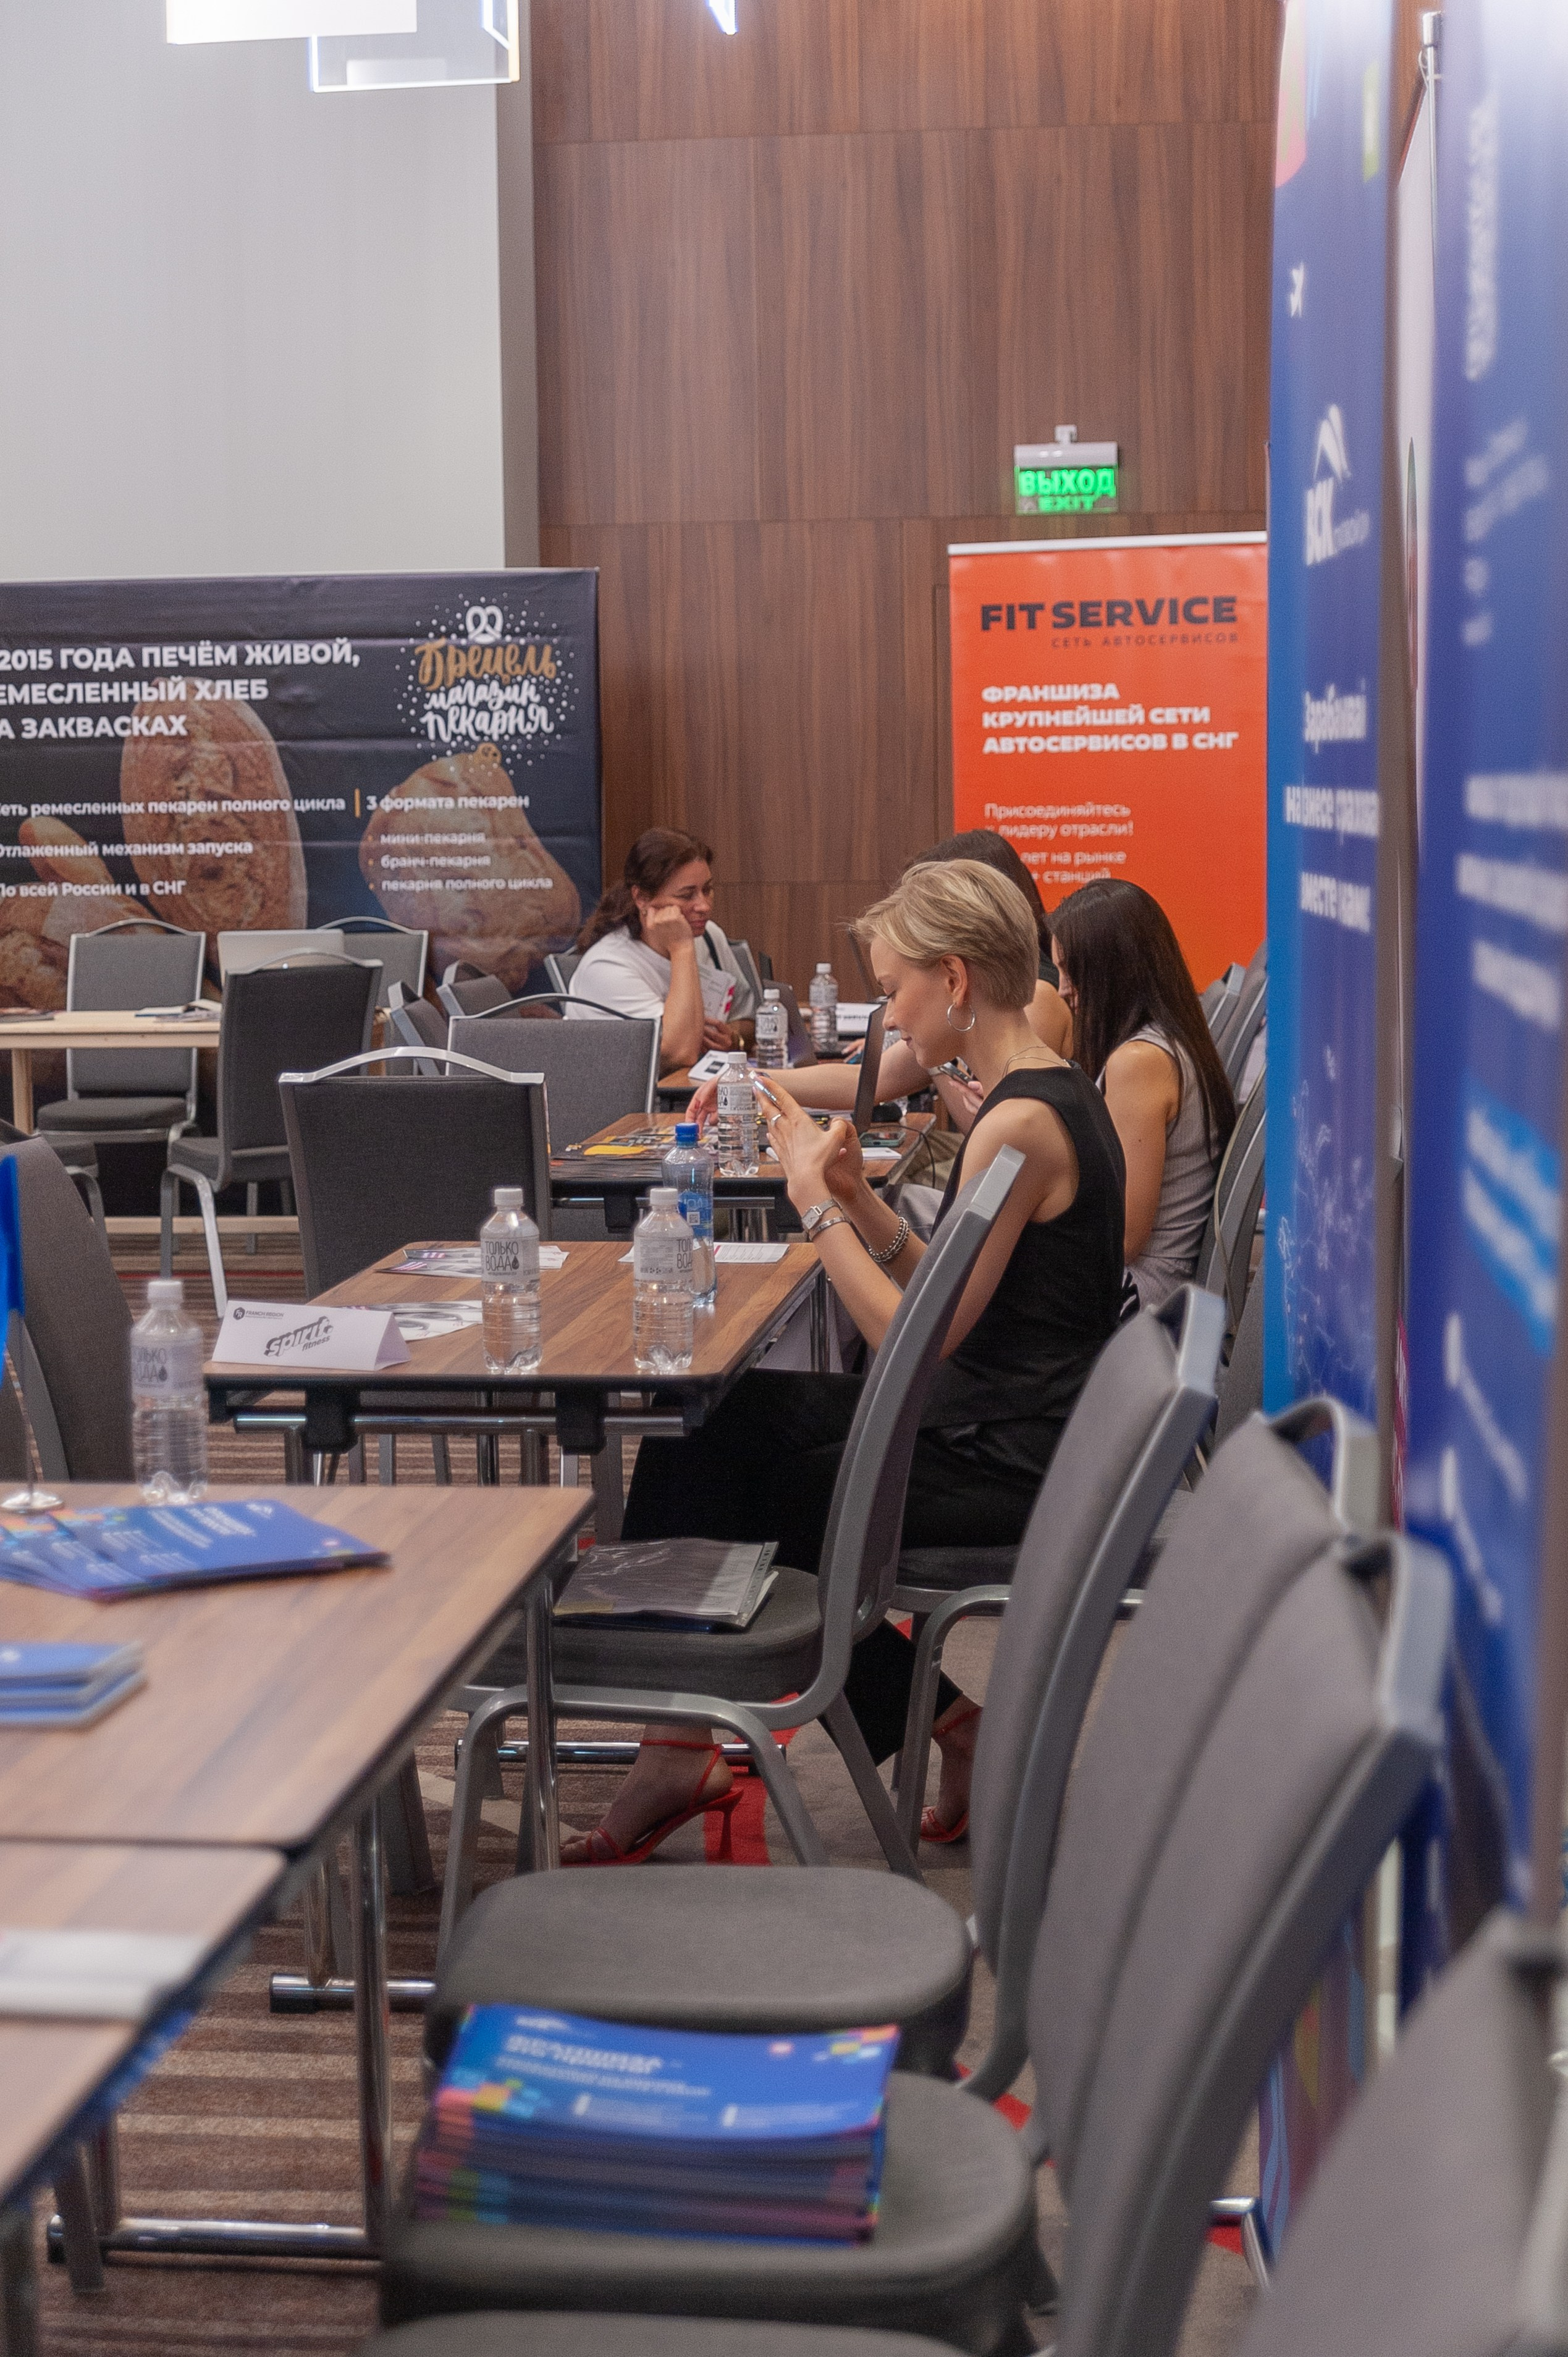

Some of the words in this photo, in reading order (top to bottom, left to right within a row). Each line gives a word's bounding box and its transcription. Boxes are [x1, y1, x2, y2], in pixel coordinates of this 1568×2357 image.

[1019, 468, 1116, 498] ВЫХОД
[980, 602, 1045, 631] FIT
[1052, 595, 1237, 629] SERVICE
[1052, 637, 1092, 648] СЕТЬ
[1102, 632, 1239, 646] АВТОСЕРВИСОВ
[0, 648, 54, 671] 2015
[60, 647, 135, 672] ГОДА
[141, 640, 237, 668] ПЕЧЁМ
[245, 637, 361, 667] ЖИВОЙ,
[415, 637, 556, 690] Брецель
[195, 679, 269, 701] ХЛЕБ
[982, 683, 1120, 703] ФРАНШИЗА
[21, 715, 188, 739] ЗАКВАСКАХ
[982, 704, 1144, 729] КРУПНЕЙШЕЙ
[1149, 706, 1211, 725] СЕТИ
[982, 734, 1168, 755] АВТОСЕРВИСОВ
[1172, 733, 1189, 750] В
[1192, 732, 1239, 749] СНГ
[0, 803, 28, 816] еть
[31, 802, 145, 818] ремесленных
[148, 801, 218, 817] пекарен
[222, 799, 290, 812] полного
[293, 797, 345, 812] цикла
[366, 796, 377, 810] 3
[380, 794, 455, 813] формата
[457, 795, 529, 811] пекарен
[102, 842, 184, 857] механизм
[187, 841, 253, 858] запуска
[19, 881, 58, 897] всей
[62, 882, 122, 896] России
[123, 884, 137, 895] и
[140, 884, 150, 895] в
[153, 881, 188, 895] СНГ
[485, 1241, 519, 1255] ТОЛЬКО
[486, 1255, 512, 1271] ВОДА
[302, 1335, 331, 1352] fitness
